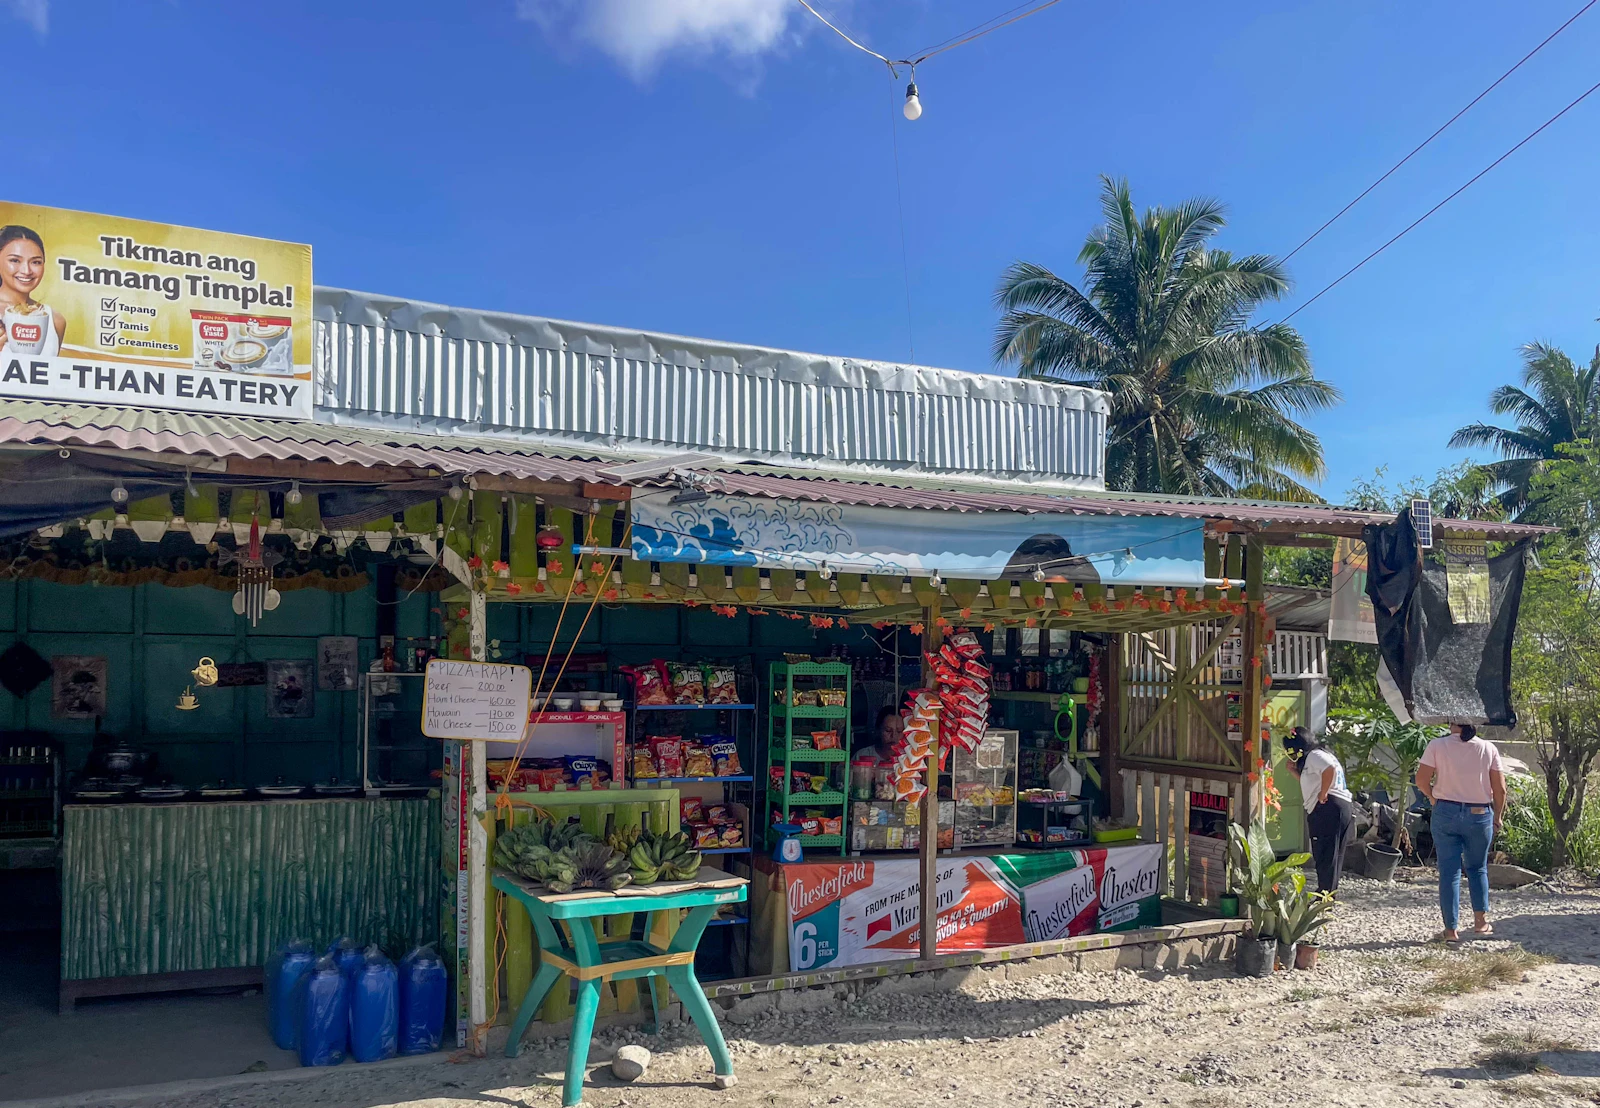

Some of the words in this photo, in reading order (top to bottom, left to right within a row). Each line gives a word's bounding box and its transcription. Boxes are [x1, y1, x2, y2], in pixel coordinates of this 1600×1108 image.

[100, 236, 202, 268] Tikman
[207, 255, 256, 280] ang
[58, 259, 180, 300] Tamang
[185, 275, 293, 309] Timpla!
[118, 303, 156, 316] Tapang
[15, 326, 37, 334] Great
[118, 321, 150, 332] Tamis
[203, 324, 224, 332] Great
[118, 337, 179, 351] Creaminess
[2, 359, 49, 385] AE
[176, 374, 299, 407] EATERY
[428, 678, 452, 693] Beef
[428, 693, 448, 704] Ham
[454, 695, 477, 704] Cheese
[428, 718, 440, 729] All
[443, 720, 472, 729] Cheese
[1190, 792, 1228, 810] BABALA!
[788, 861, 866, 916] Chesterfield
[865, 898, 888, 916] FROM
[889, 889, 906, 904] THE
[942, 868, 954, 880] OF
[950, 908, 962, 920] KA
[964, 902, 975, 916] SA
[1026, 868, 1097, 942] Chesterfield
[936, 921, 958, 944] AVOR
[959, 916, 967, 930] &
[969, 896, 1009, 926] QUALITY!
[1112, 911, 1134, 924] Marlboro
[795, 922, 818, 969] 6
[818, 940, 829, 949] PER
